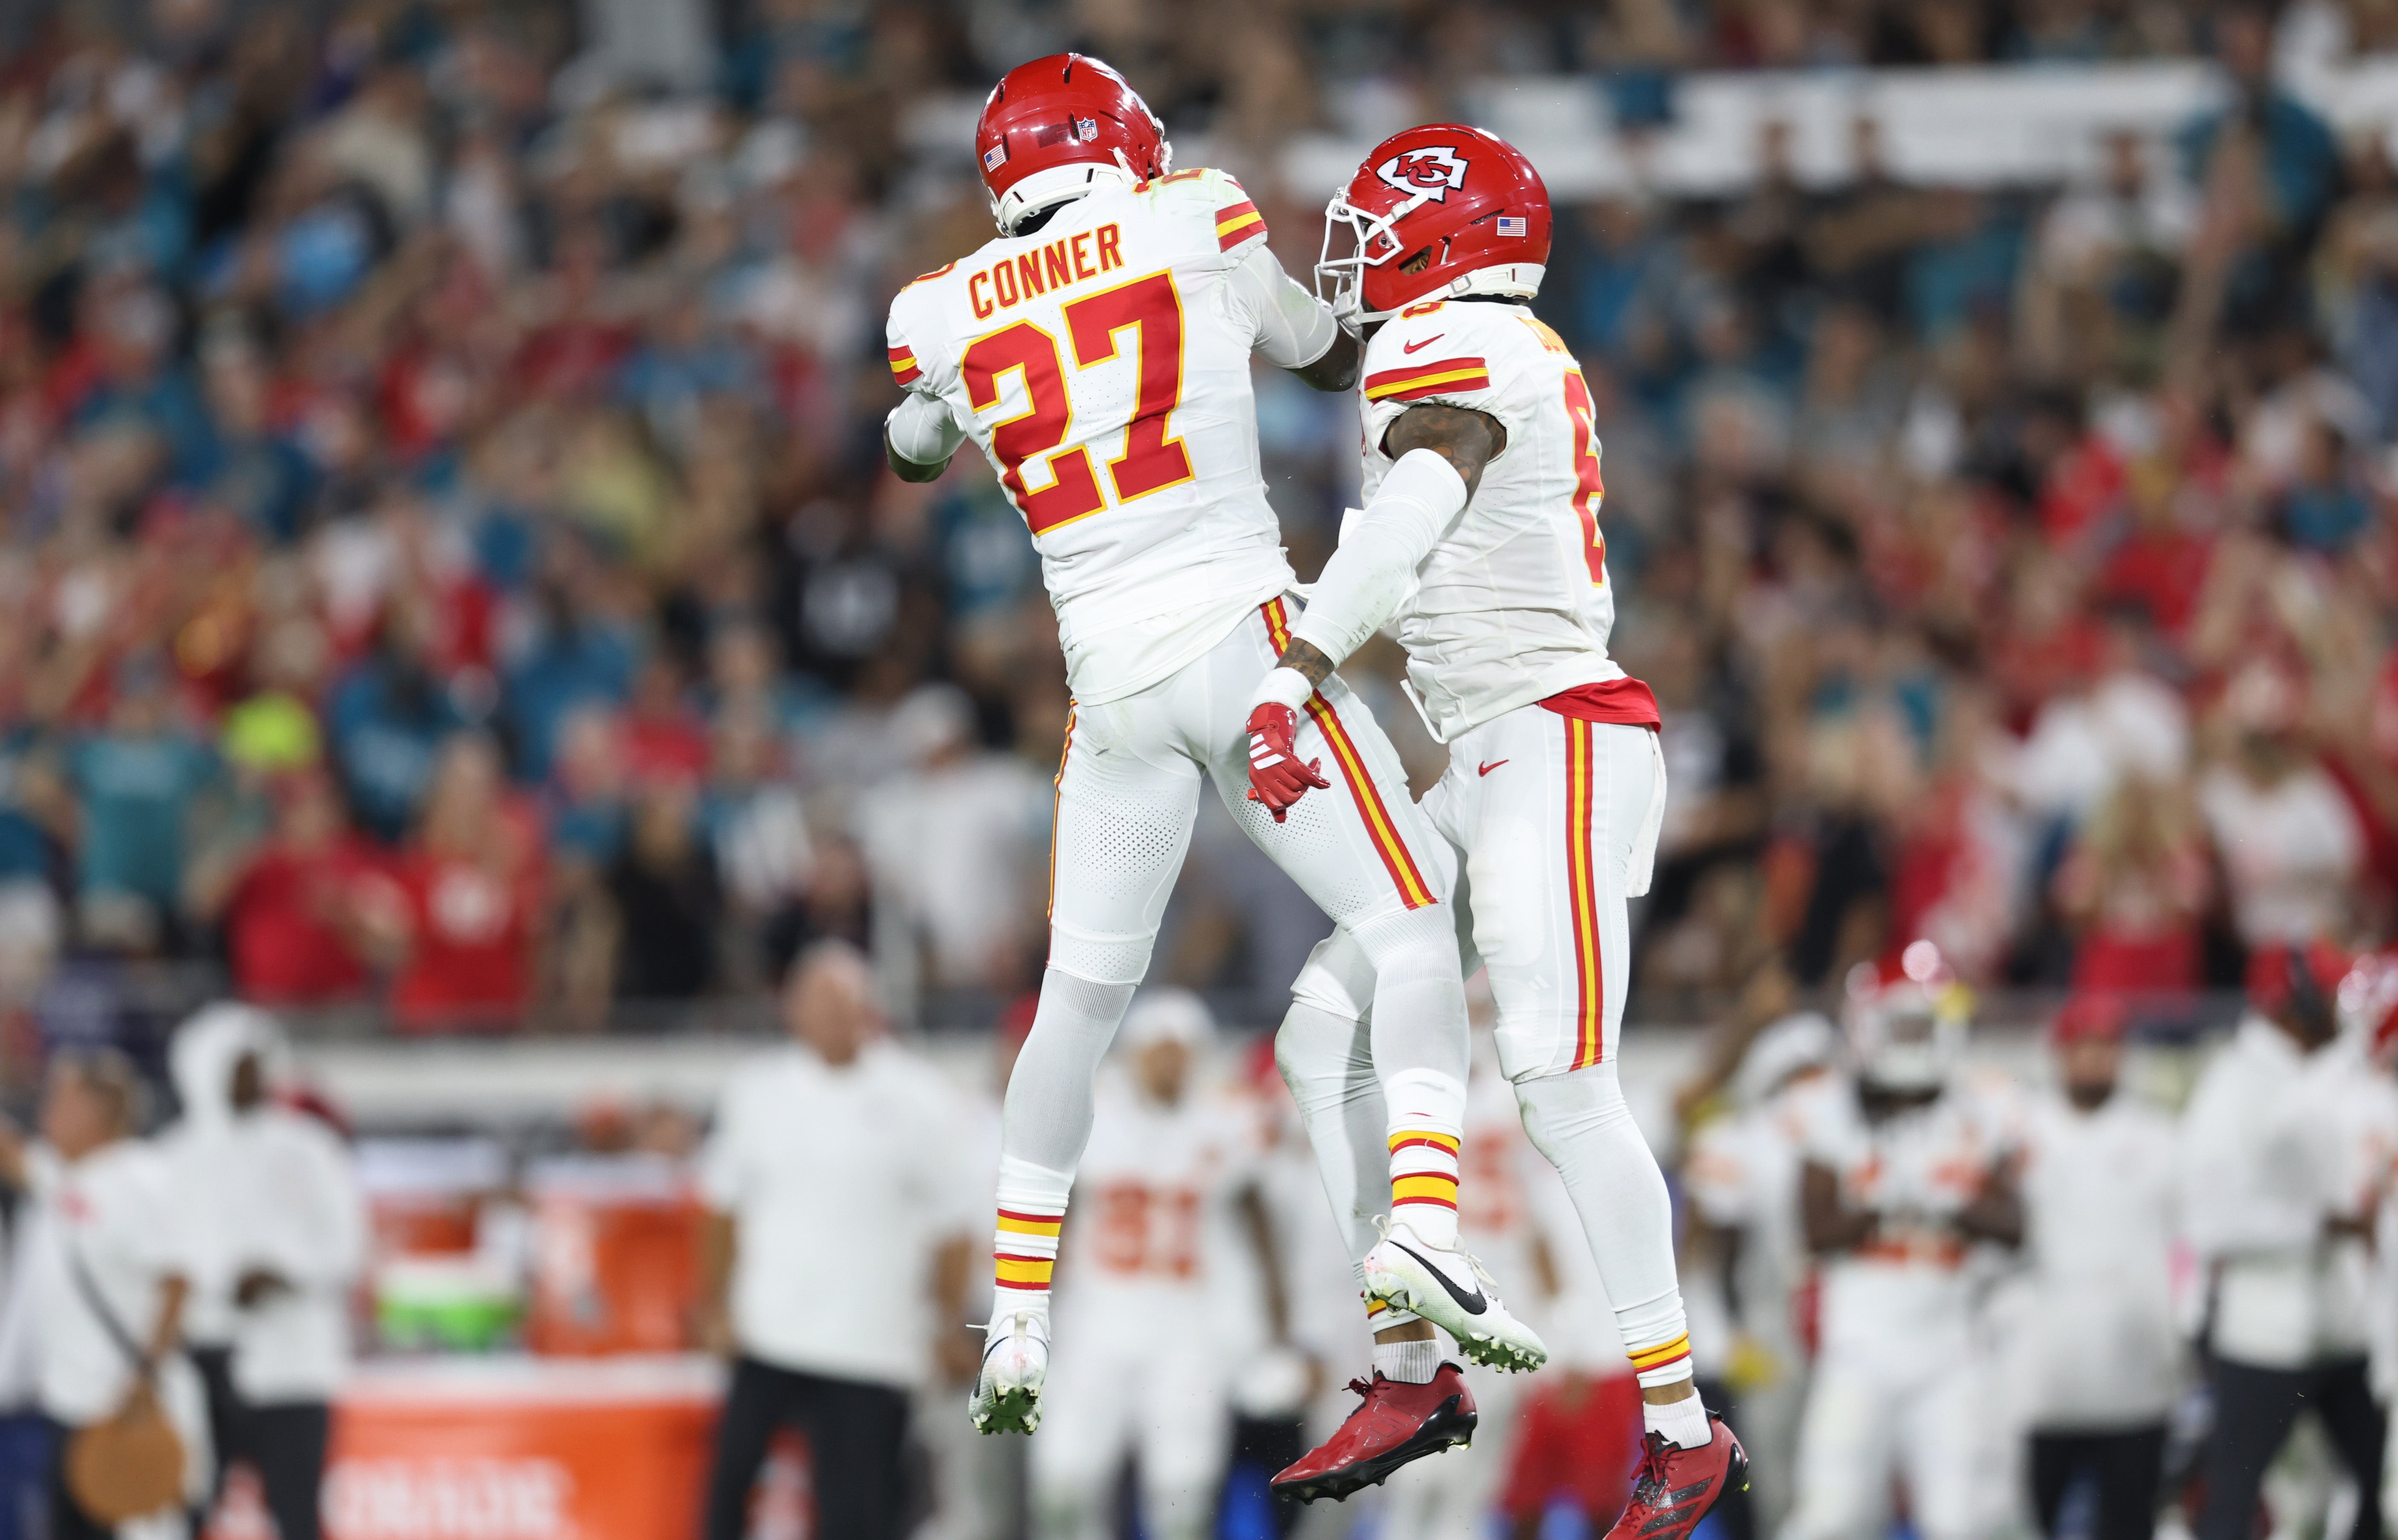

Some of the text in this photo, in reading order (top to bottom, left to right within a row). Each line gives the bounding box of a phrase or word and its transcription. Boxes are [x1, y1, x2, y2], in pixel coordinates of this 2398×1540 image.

[1082, 128, 1095, 137] NFL
[1393, 155, 1453, 188] KC
[968, 222, 1125, 321] CONNER
[960, 268, 1196, 538] 27
